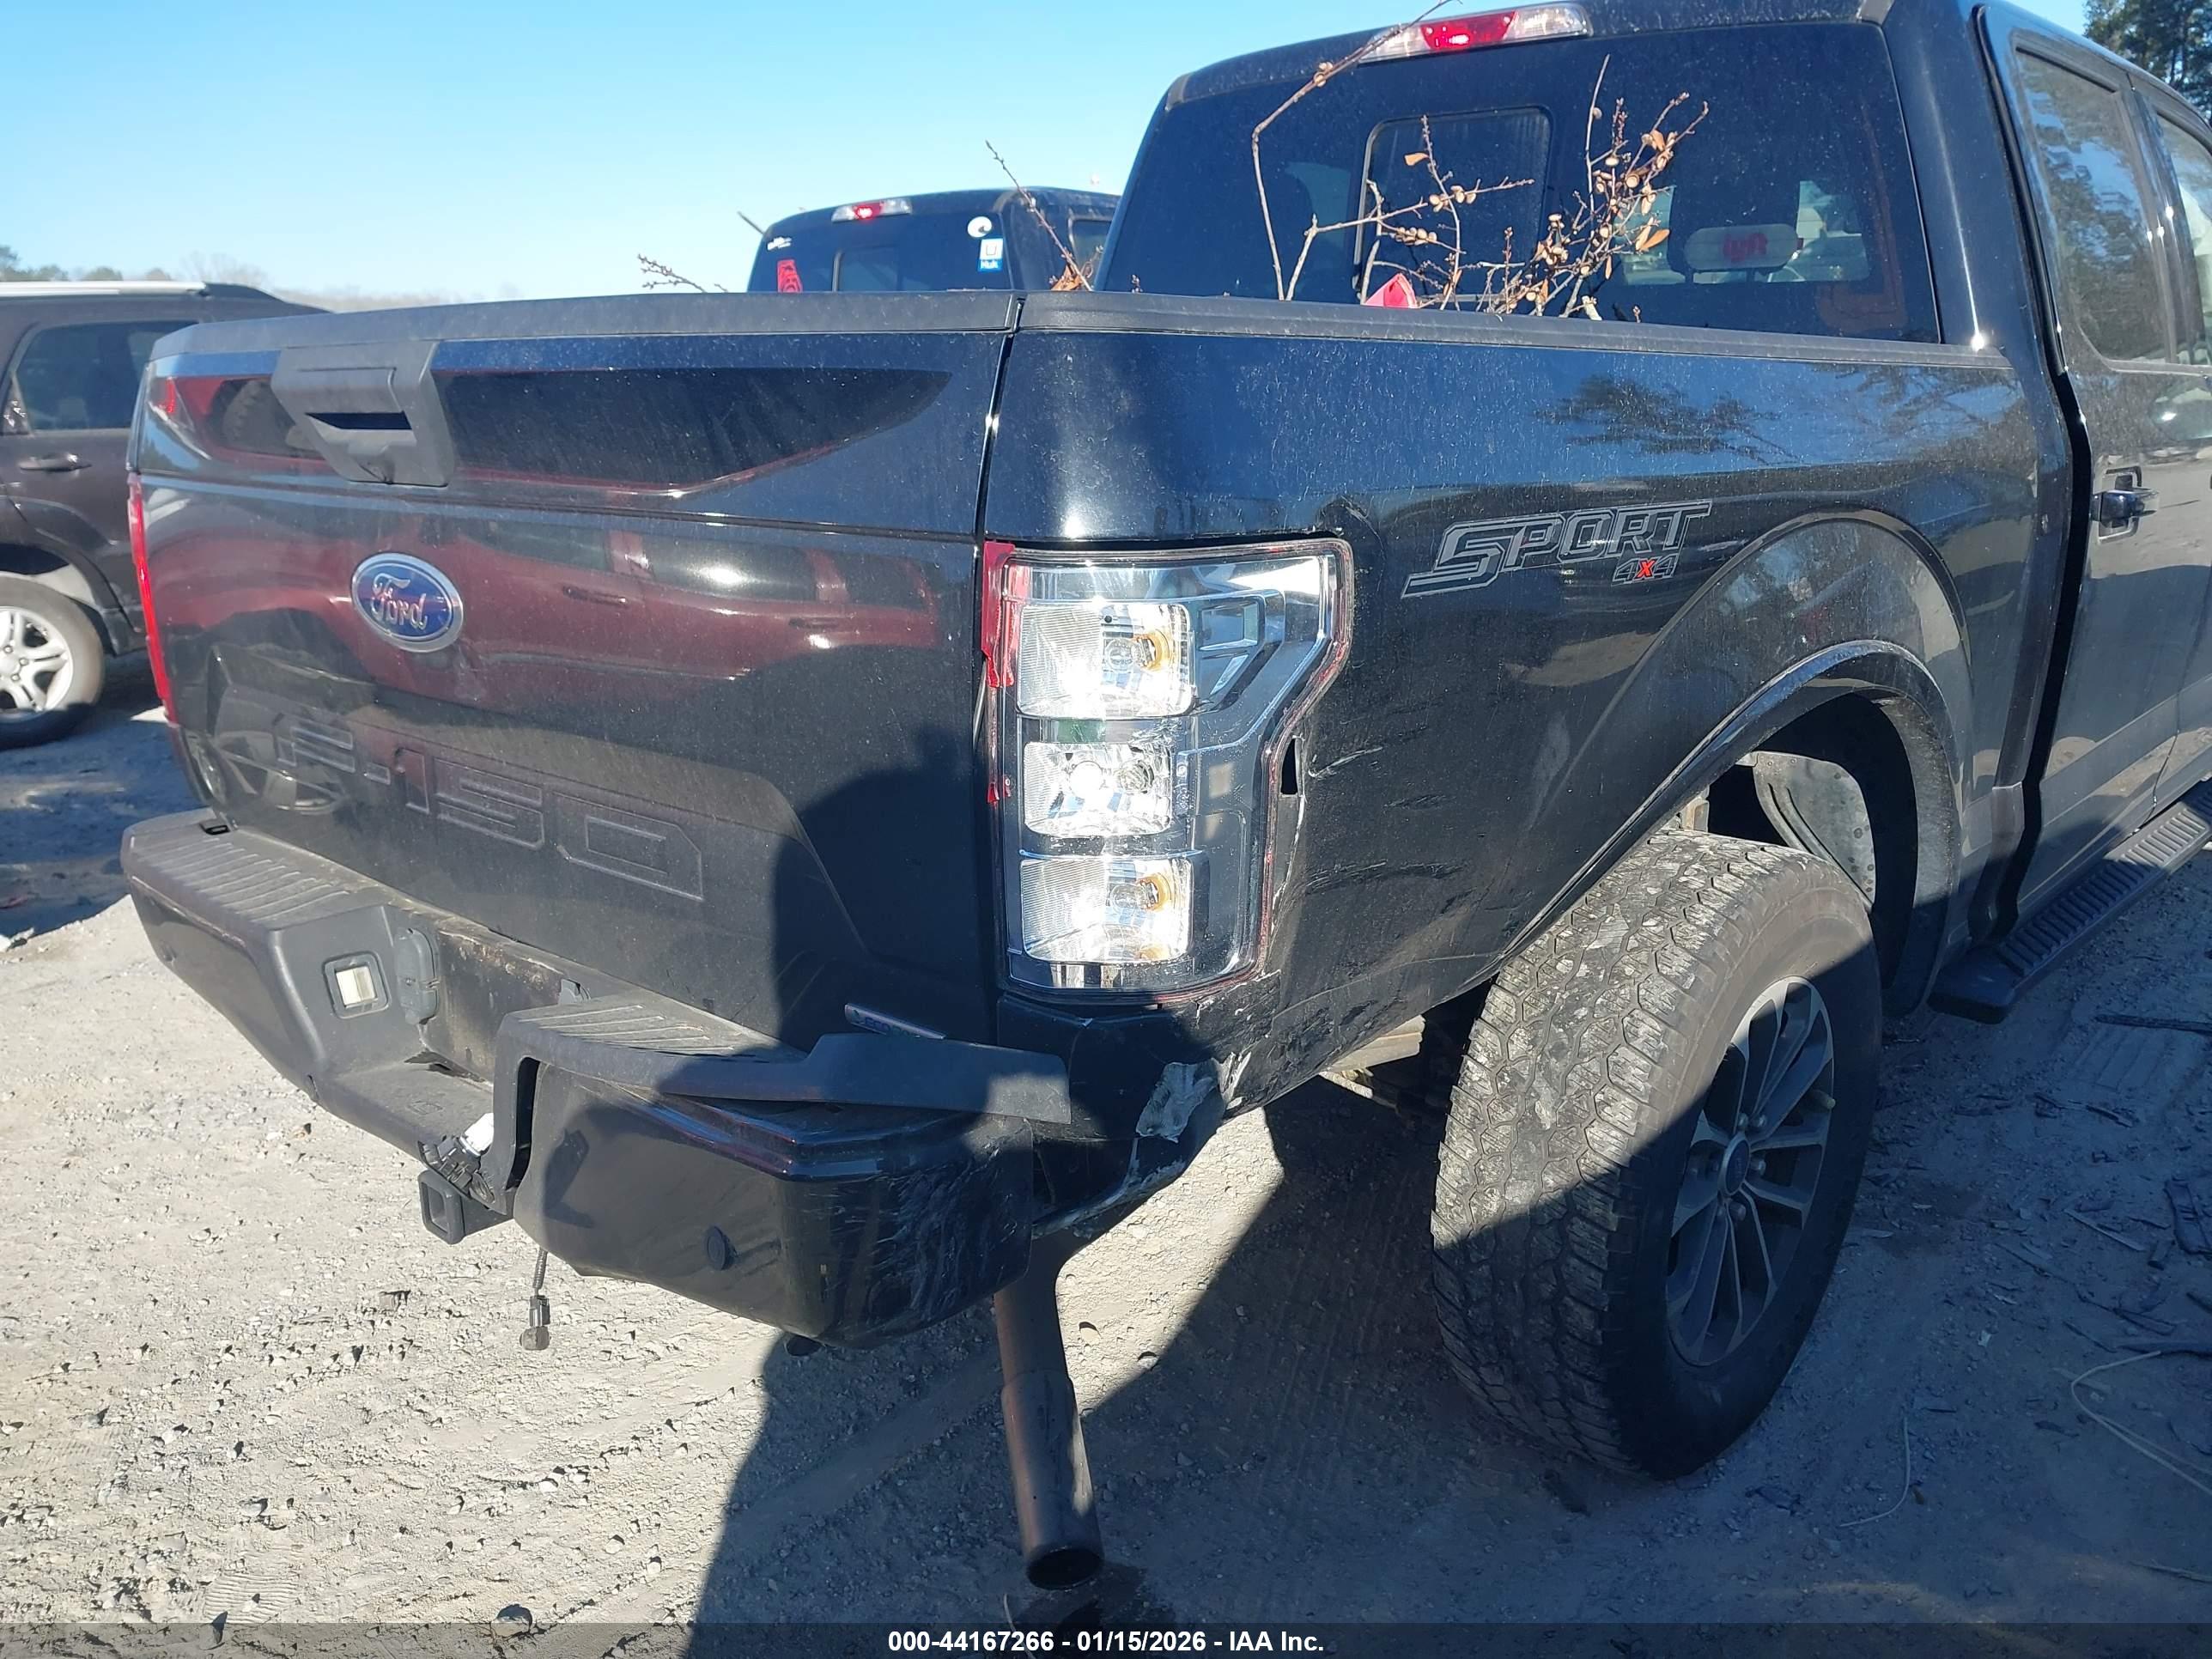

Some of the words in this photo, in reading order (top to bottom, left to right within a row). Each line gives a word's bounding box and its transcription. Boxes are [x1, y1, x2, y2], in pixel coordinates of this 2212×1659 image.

[1401, 499, 1712, 599] SPORT
[371, 573, 428, 629] Ford
[273, 713, 704, 902] F-150
